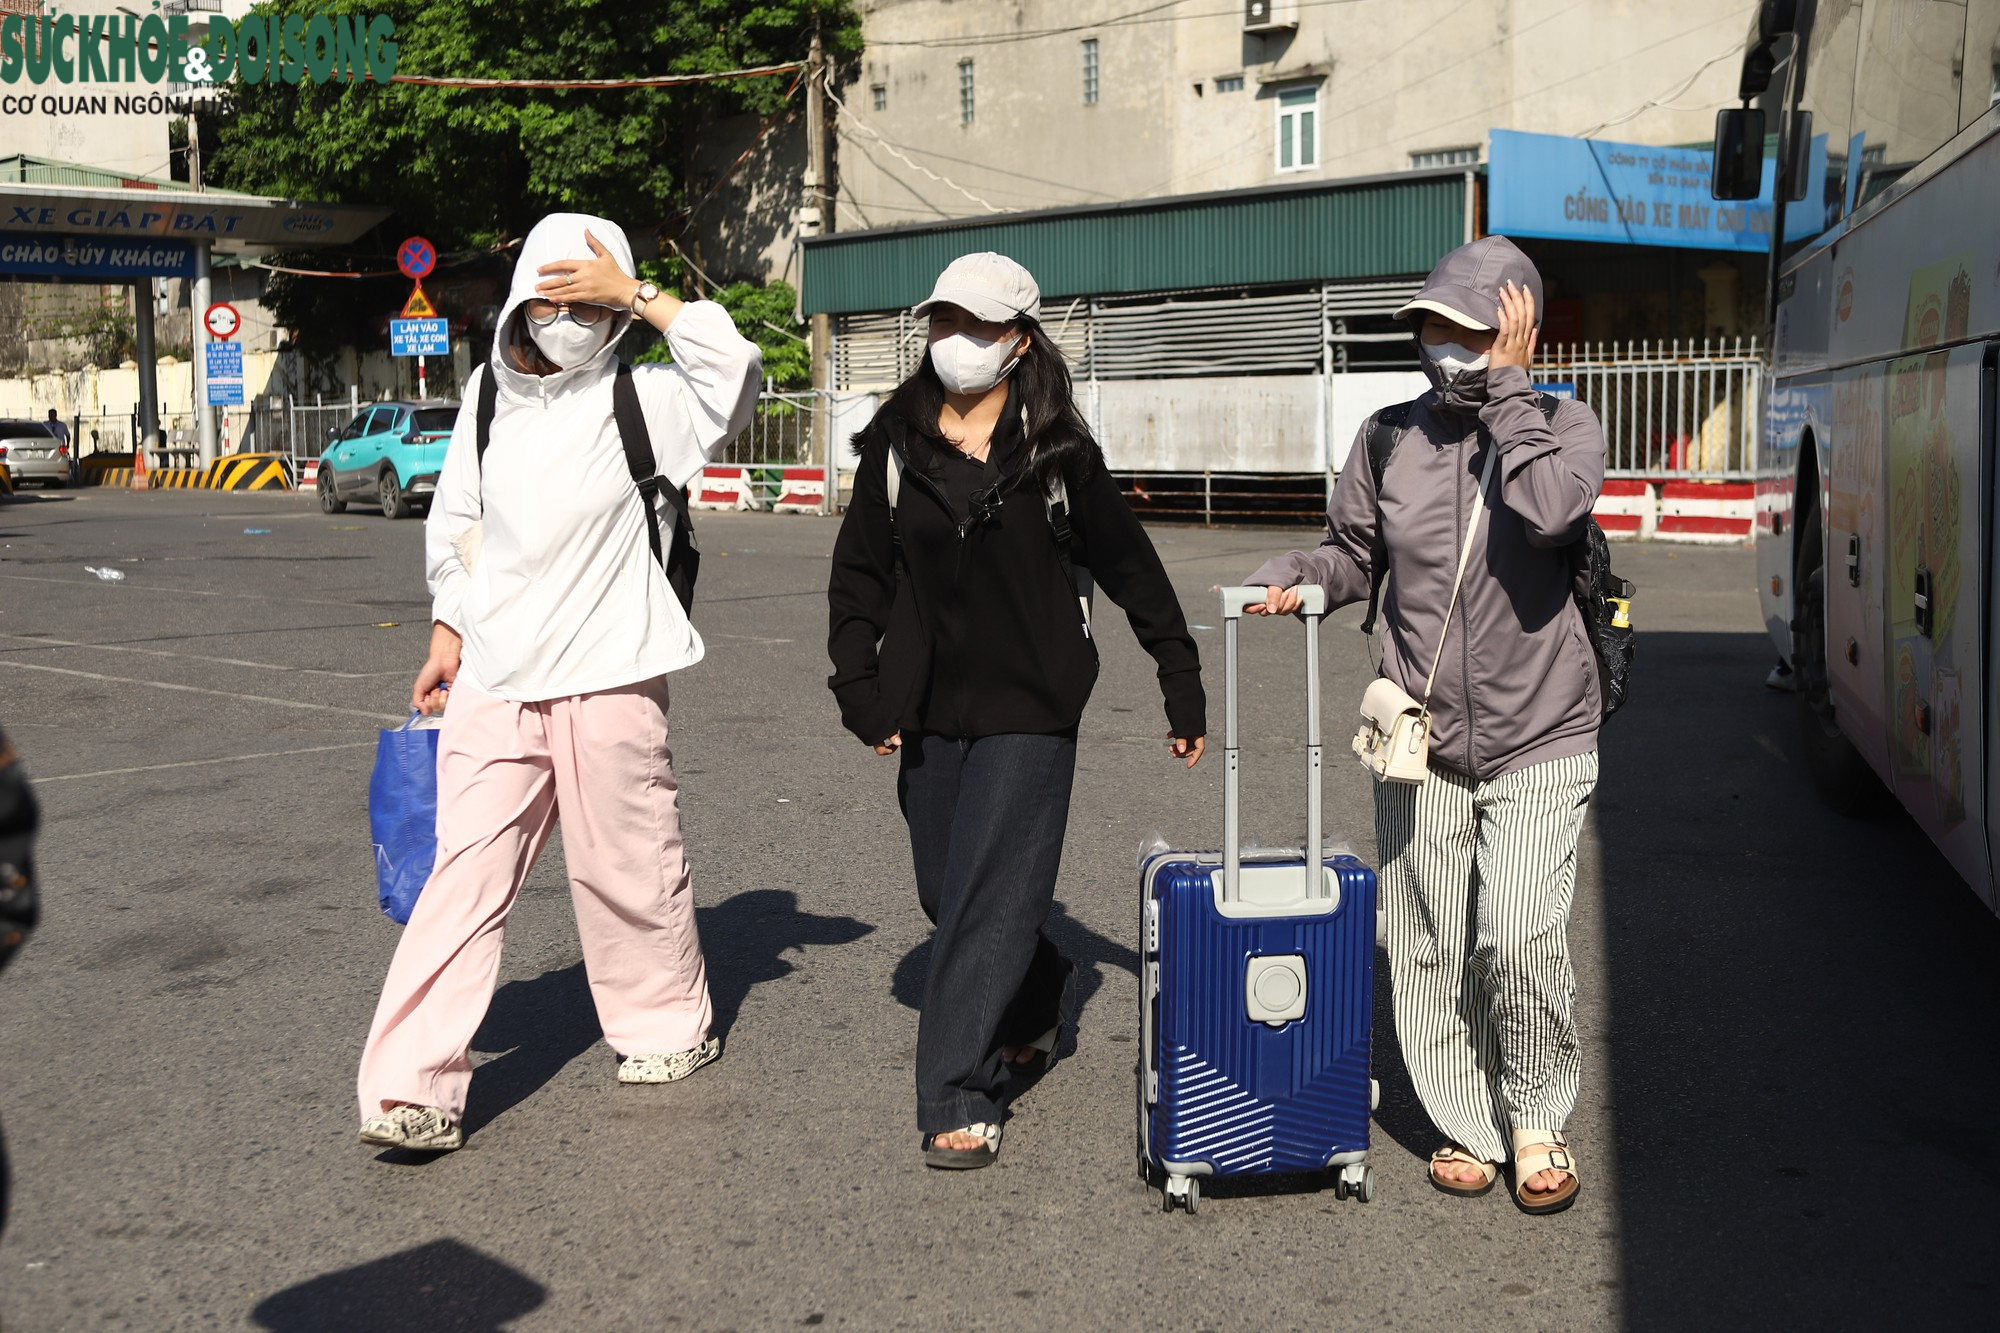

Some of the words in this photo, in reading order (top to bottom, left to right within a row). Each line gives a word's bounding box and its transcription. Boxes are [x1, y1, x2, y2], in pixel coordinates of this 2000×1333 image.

[7, 206, 56, 225] XE
[173, 208, 243, 233] BÁT
[1564, 187, 1608, 222] CỔNG
[1617, 195, 1646, 225] VÀO
[1652, 201, 1672, 228] XE
[1678, 198, 1710, 230] MÁY
[2, 240, 58, 263] CHÀO
[109, 245, 186, 268] KHÁCH!
[420, 321, 438, 333] VÀO
